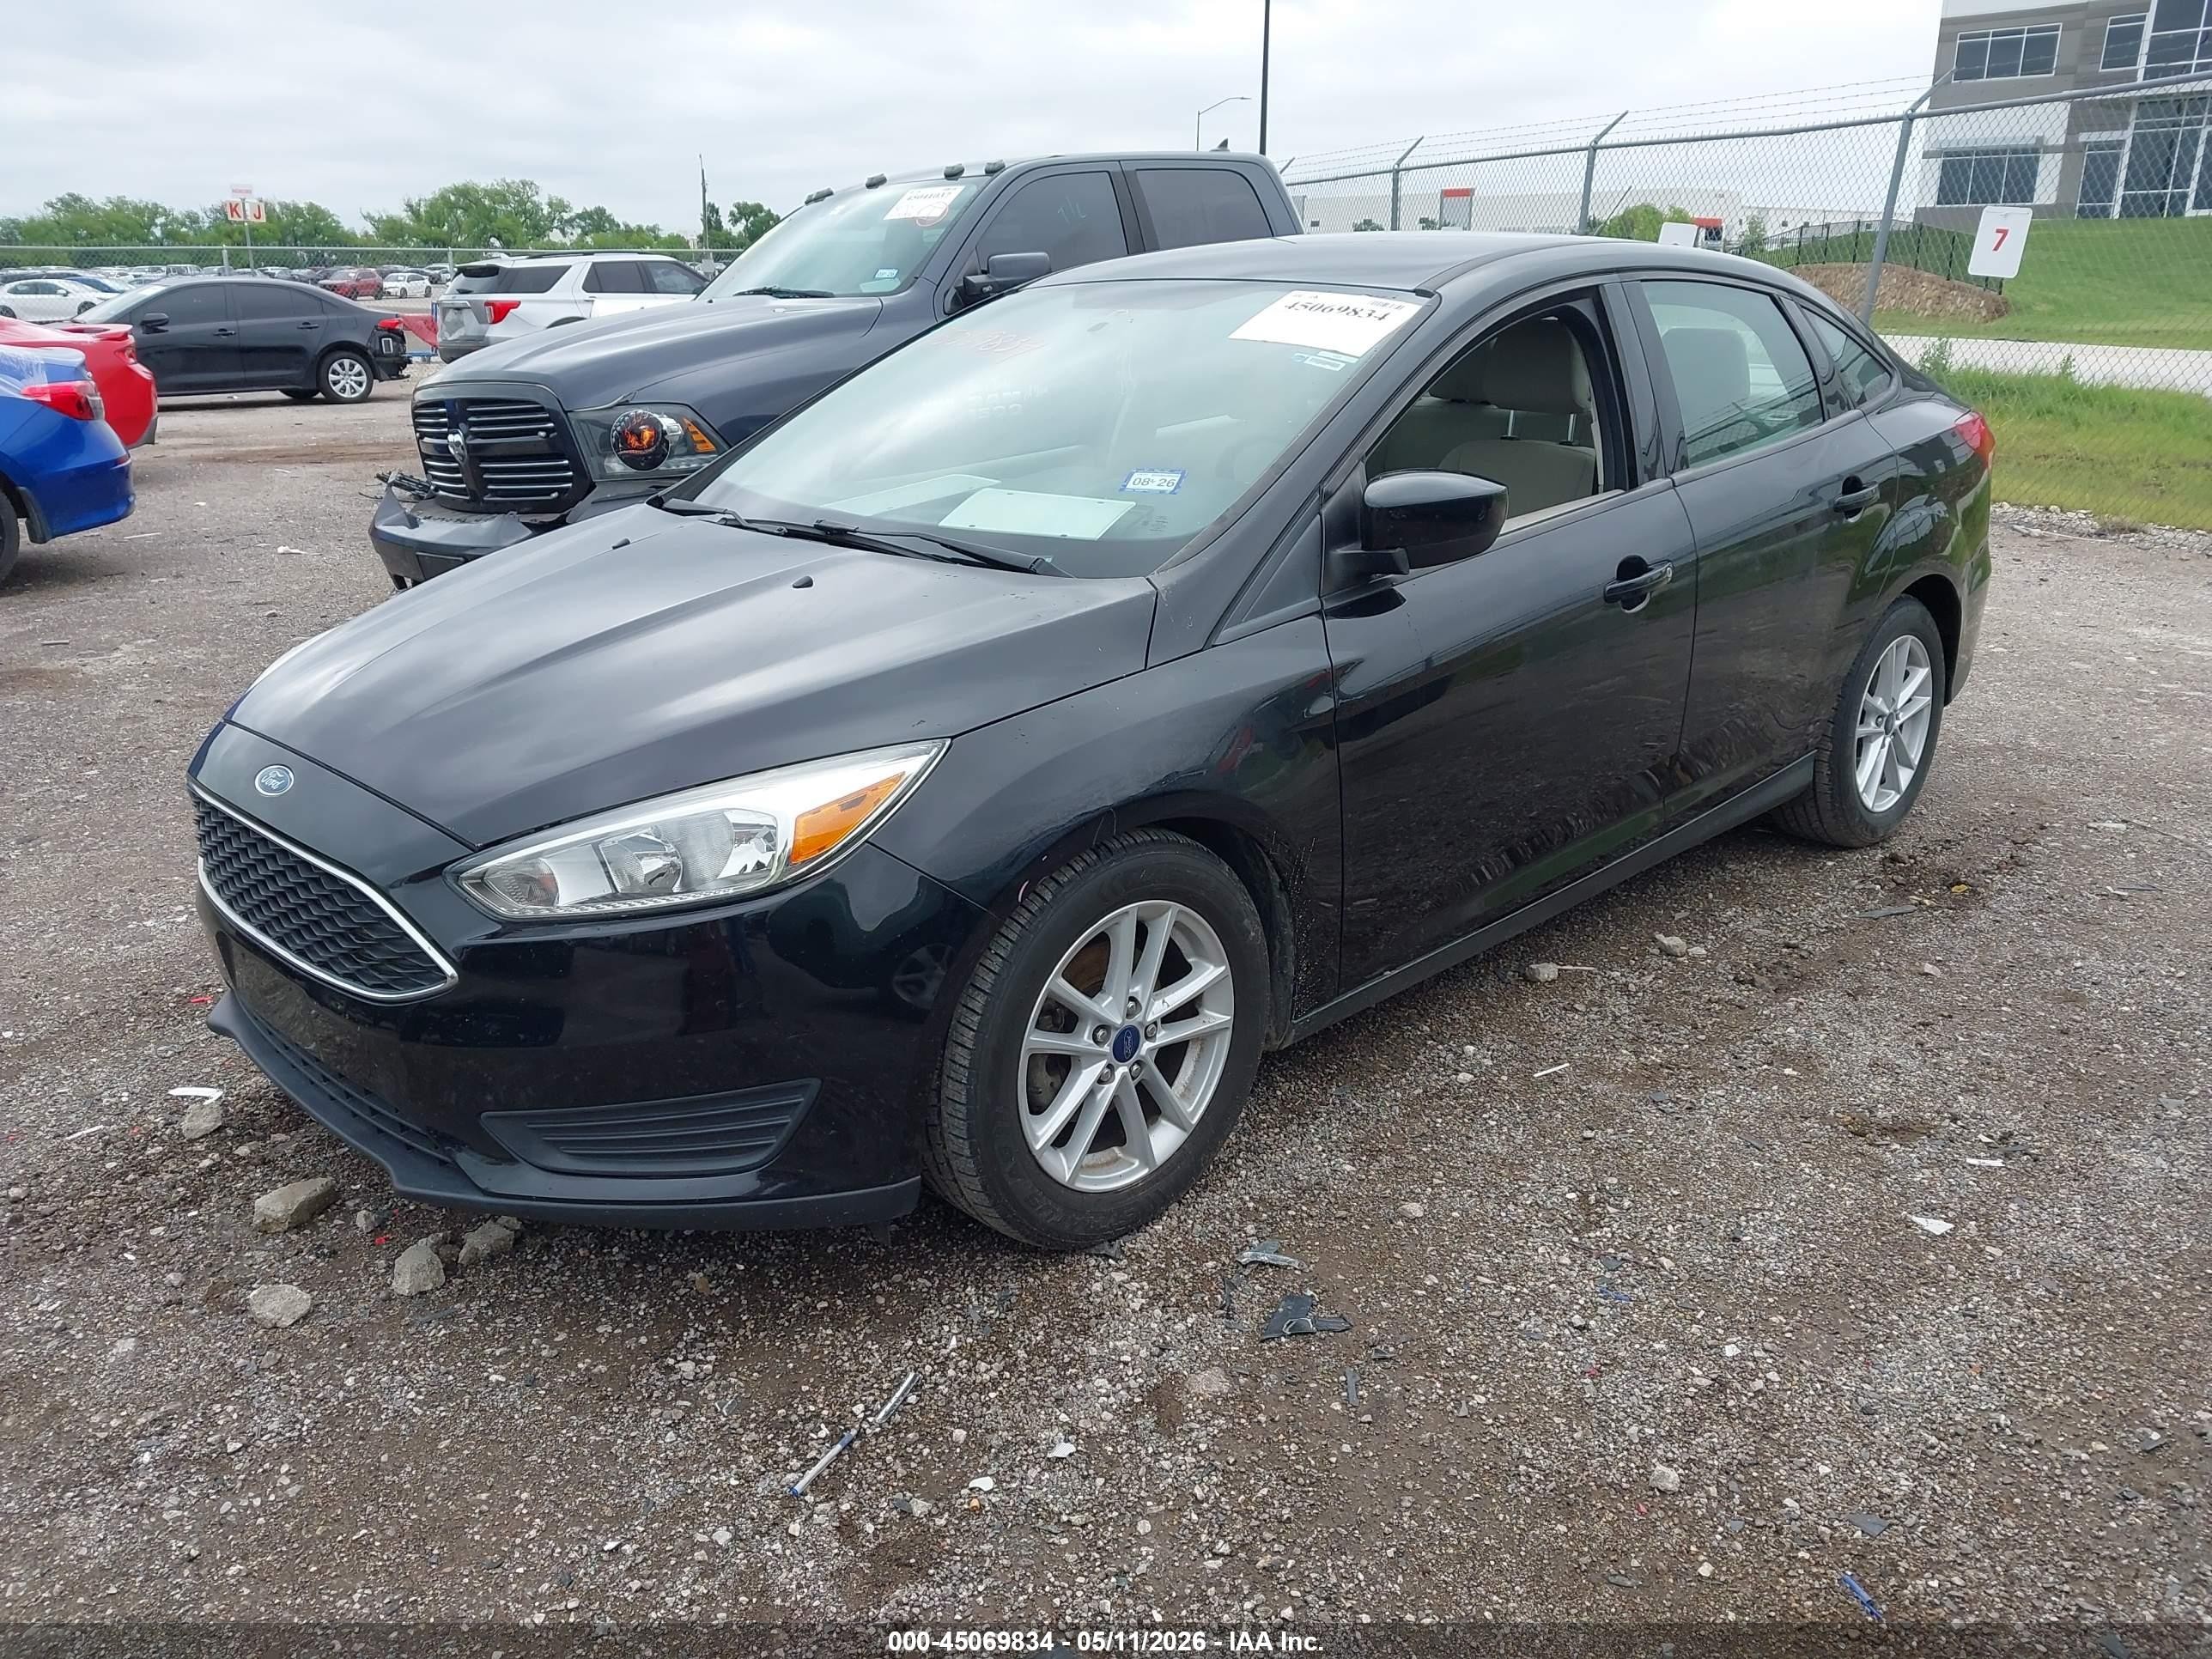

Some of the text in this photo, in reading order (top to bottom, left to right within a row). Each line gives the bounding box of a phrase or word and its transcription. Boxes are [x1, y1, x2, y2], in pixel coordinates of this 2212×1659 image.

[228, 202, 262, 220] K J
[1993, 228, 2009, 252] 7
[1284, 301, 1391, 321] 45069834
[260, 770, 285, 789] Ford
